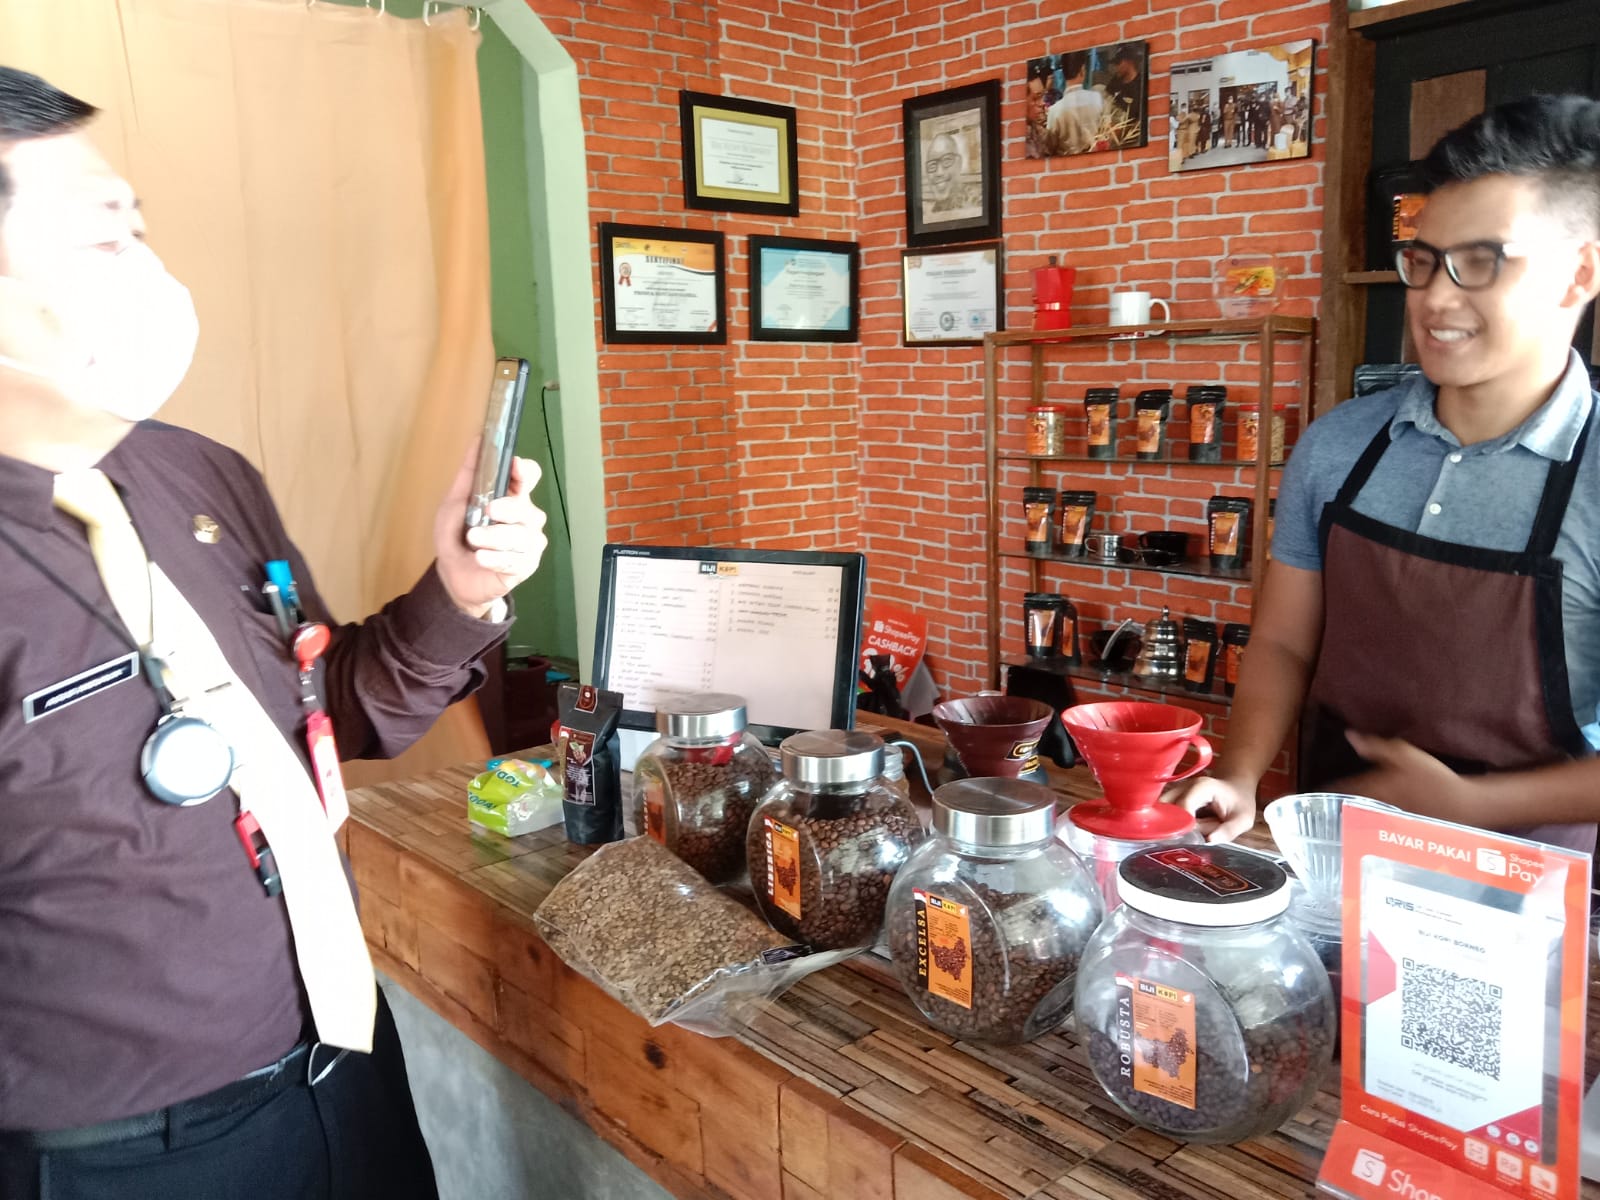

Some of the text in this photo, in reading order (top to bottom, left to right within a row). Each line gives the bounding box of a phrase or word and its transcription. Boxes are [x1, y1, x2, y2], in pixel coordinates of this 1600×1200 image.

[868, 635, 919, 657] CASHBACK
[1378, 829, 1424, 851] BAYAR
[1427, 841, 1472, 863] PAKAI
[1509, 853, 1545, 869] Shopee
[766, 832, 774, 896] LIBERICA
[1508, 863, 1545, 888] Pay
[917, 910, 927, 977] EXCELSA
[1120, 997, 1131, 1078] ROBUSTA
